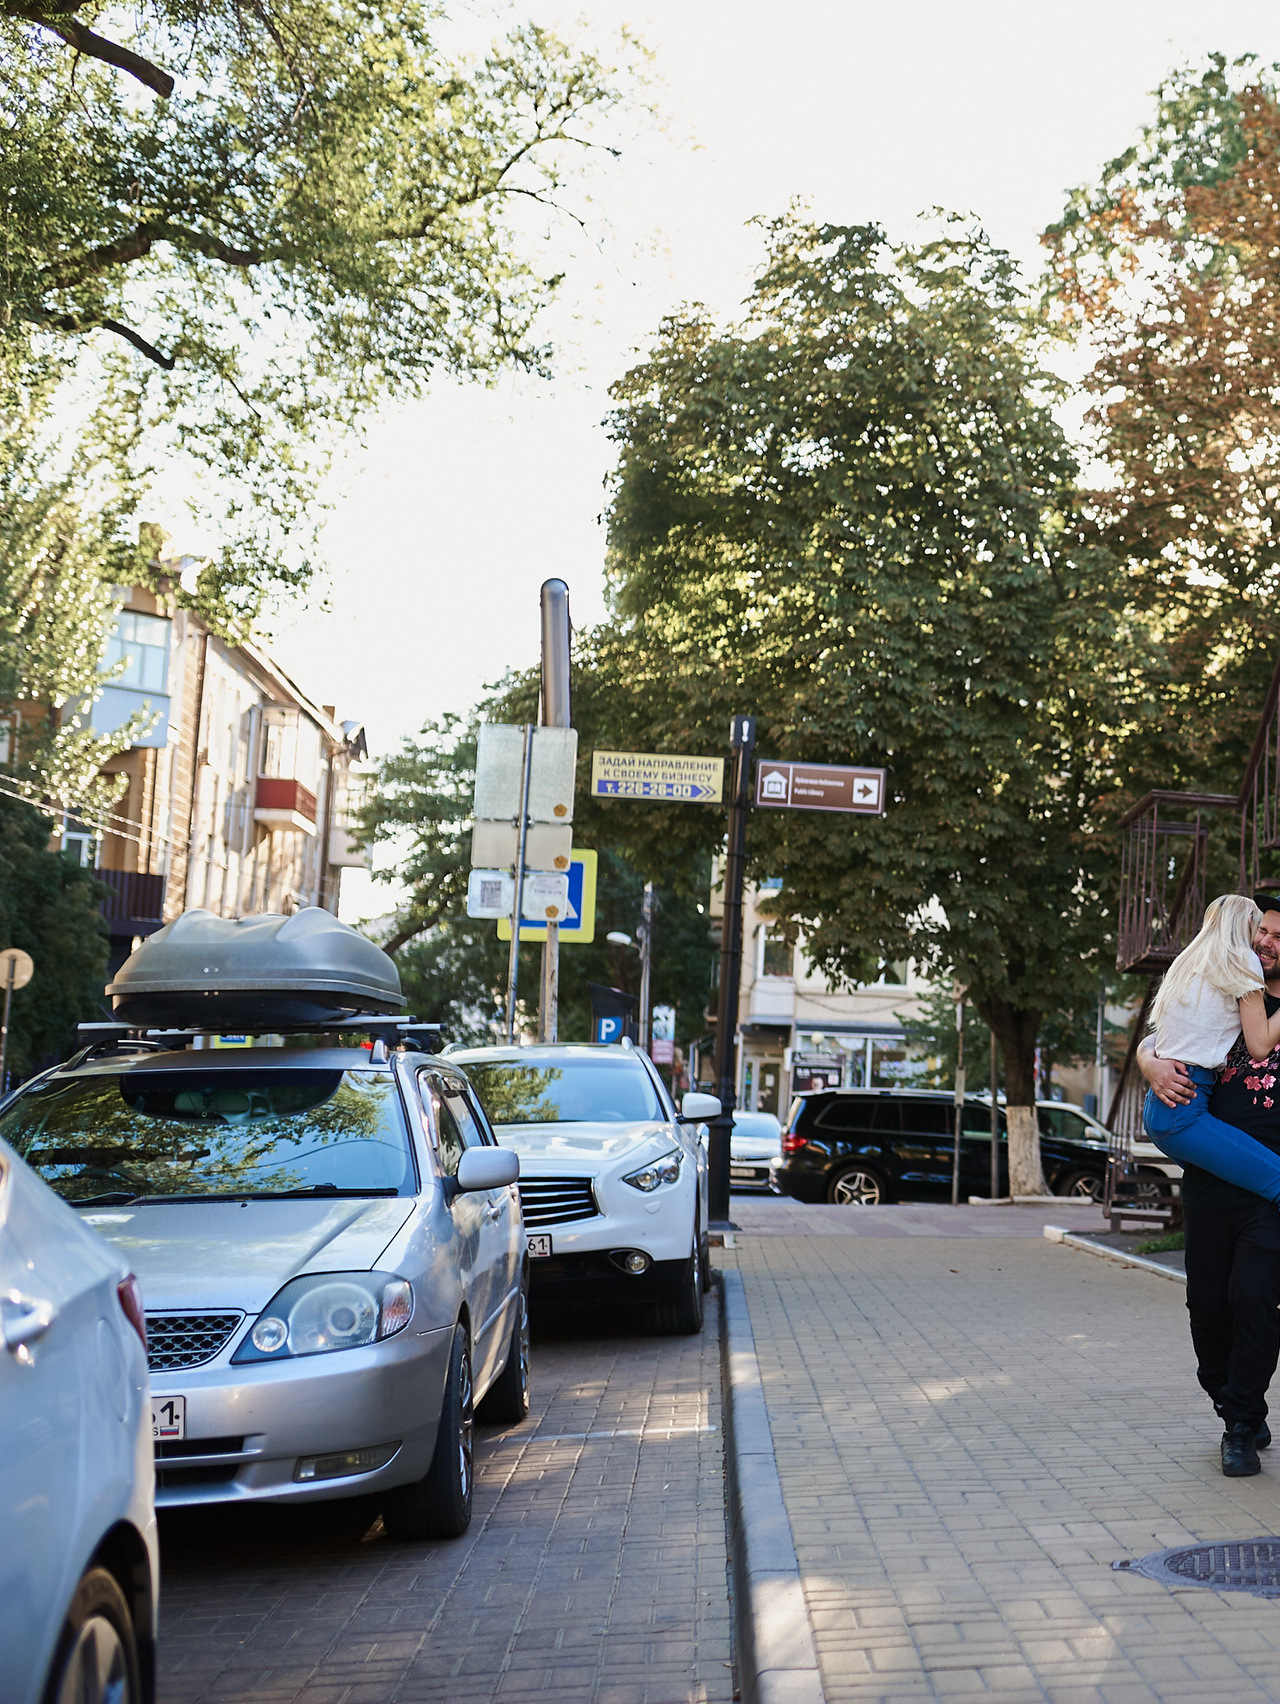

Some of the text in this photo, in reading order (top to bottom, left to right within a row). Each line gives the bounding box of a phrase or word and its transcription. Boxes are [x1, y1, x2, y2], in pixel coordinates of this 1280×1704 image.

[599, 754, 719, 772] ЗАДАЙ НАПРАВЛЕНИЕ
[603, 769, 713, 782] К СВОЕМУ БИЗНЕСУ
[601, 1019, 616, 1041] P
[528, 1238, 545, 1251] 61
